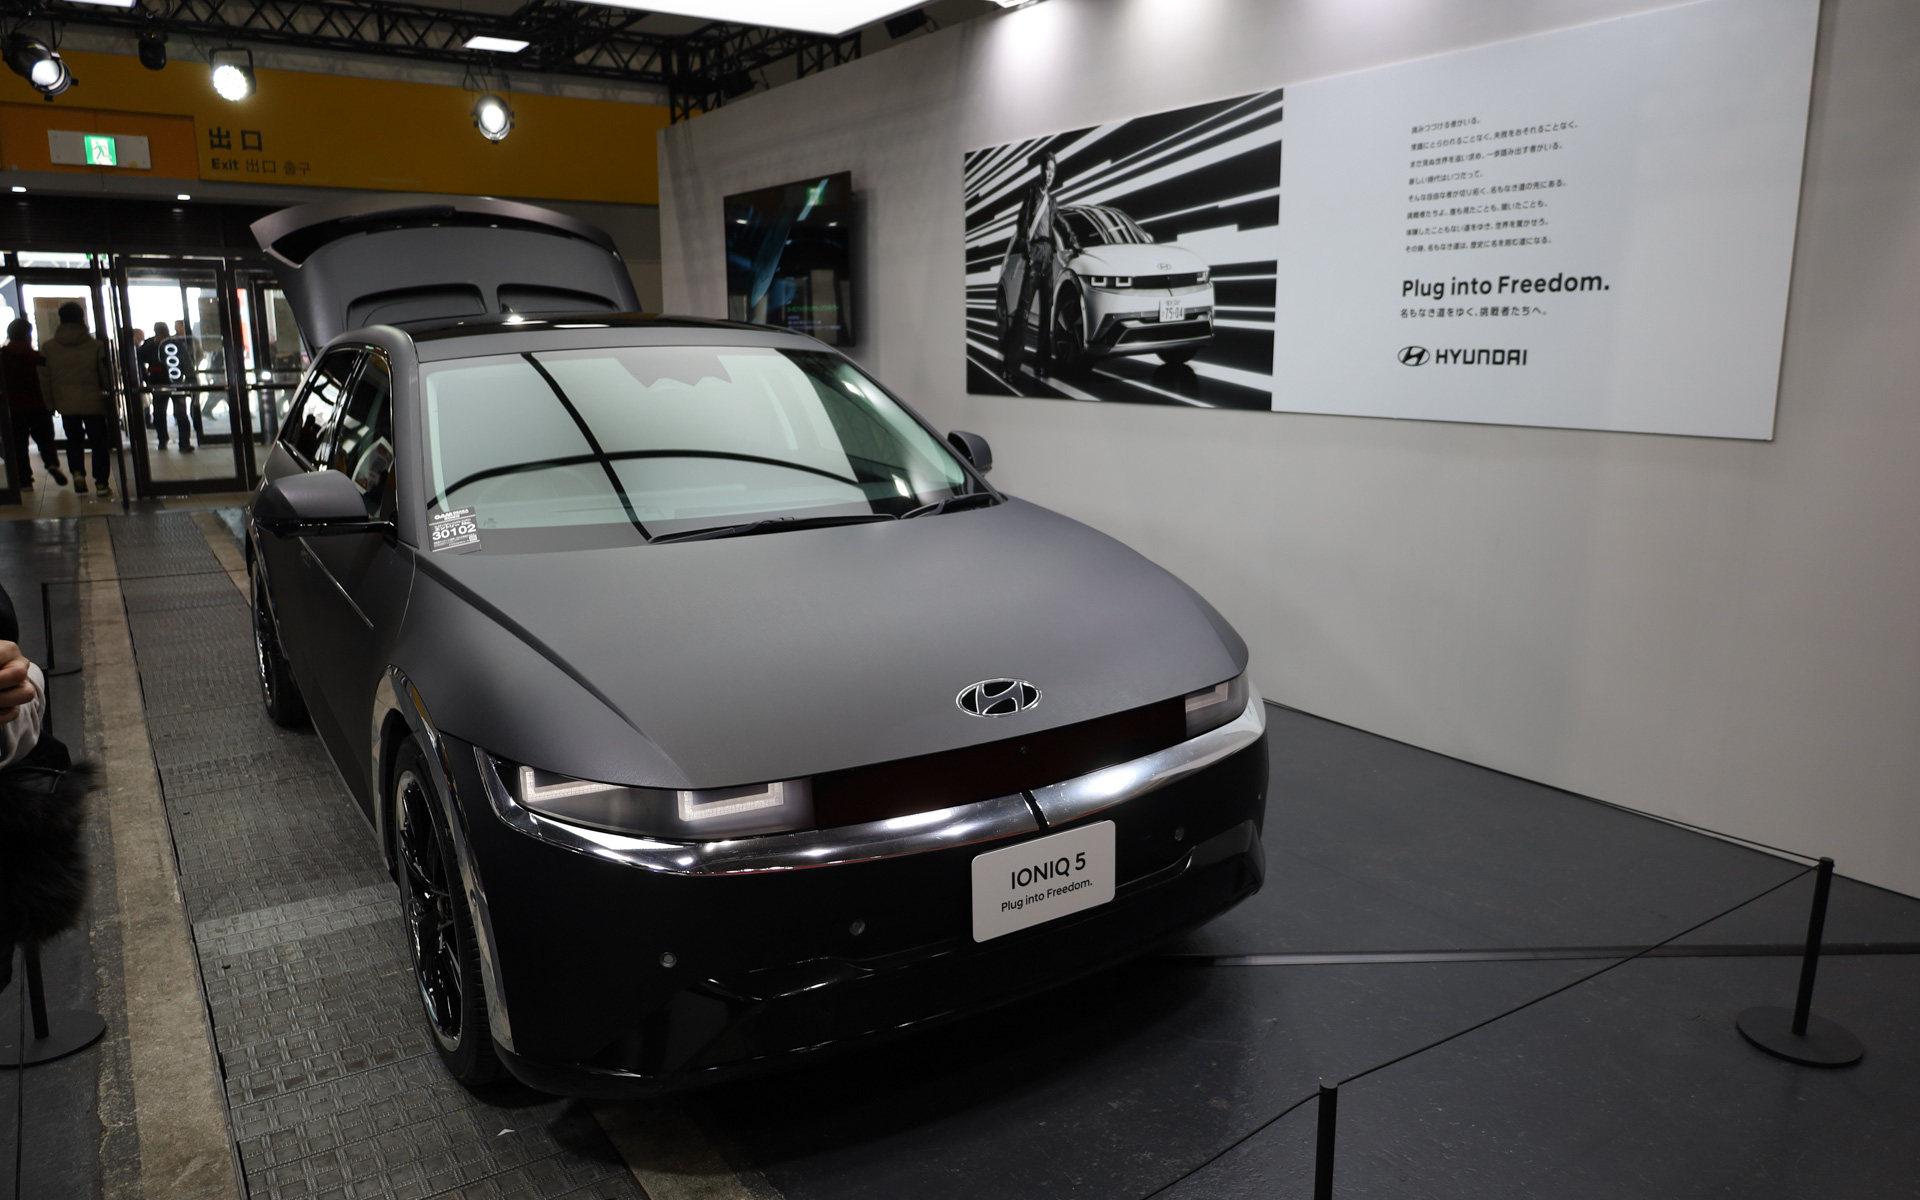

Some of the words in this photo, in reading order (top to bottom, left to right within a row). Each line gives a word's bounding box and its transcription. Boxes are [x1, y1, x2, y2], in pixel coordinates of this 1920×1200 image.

[208, 126, 262, 151] 出口
[211, 157, 239, 171] Exit
[246, 158, 277, 174] 出口
[1402, 279, 1445, 300] Plug
[1450, 277, 1492, 296] into
[1498, 273, 1610, 294] Freedom.
[1435, 348, 1528, 366] HYUNDAI
[432, 524, 477, 540] 30102
[1011, 857, 1070, 890] IONIQ
[1075, 852, 1086, 870] 5
[1001, 899, 1024, 912] Plug
[1025, 893, 1045, 905] into
[1047, 879, 1093, 899] Freedom.
